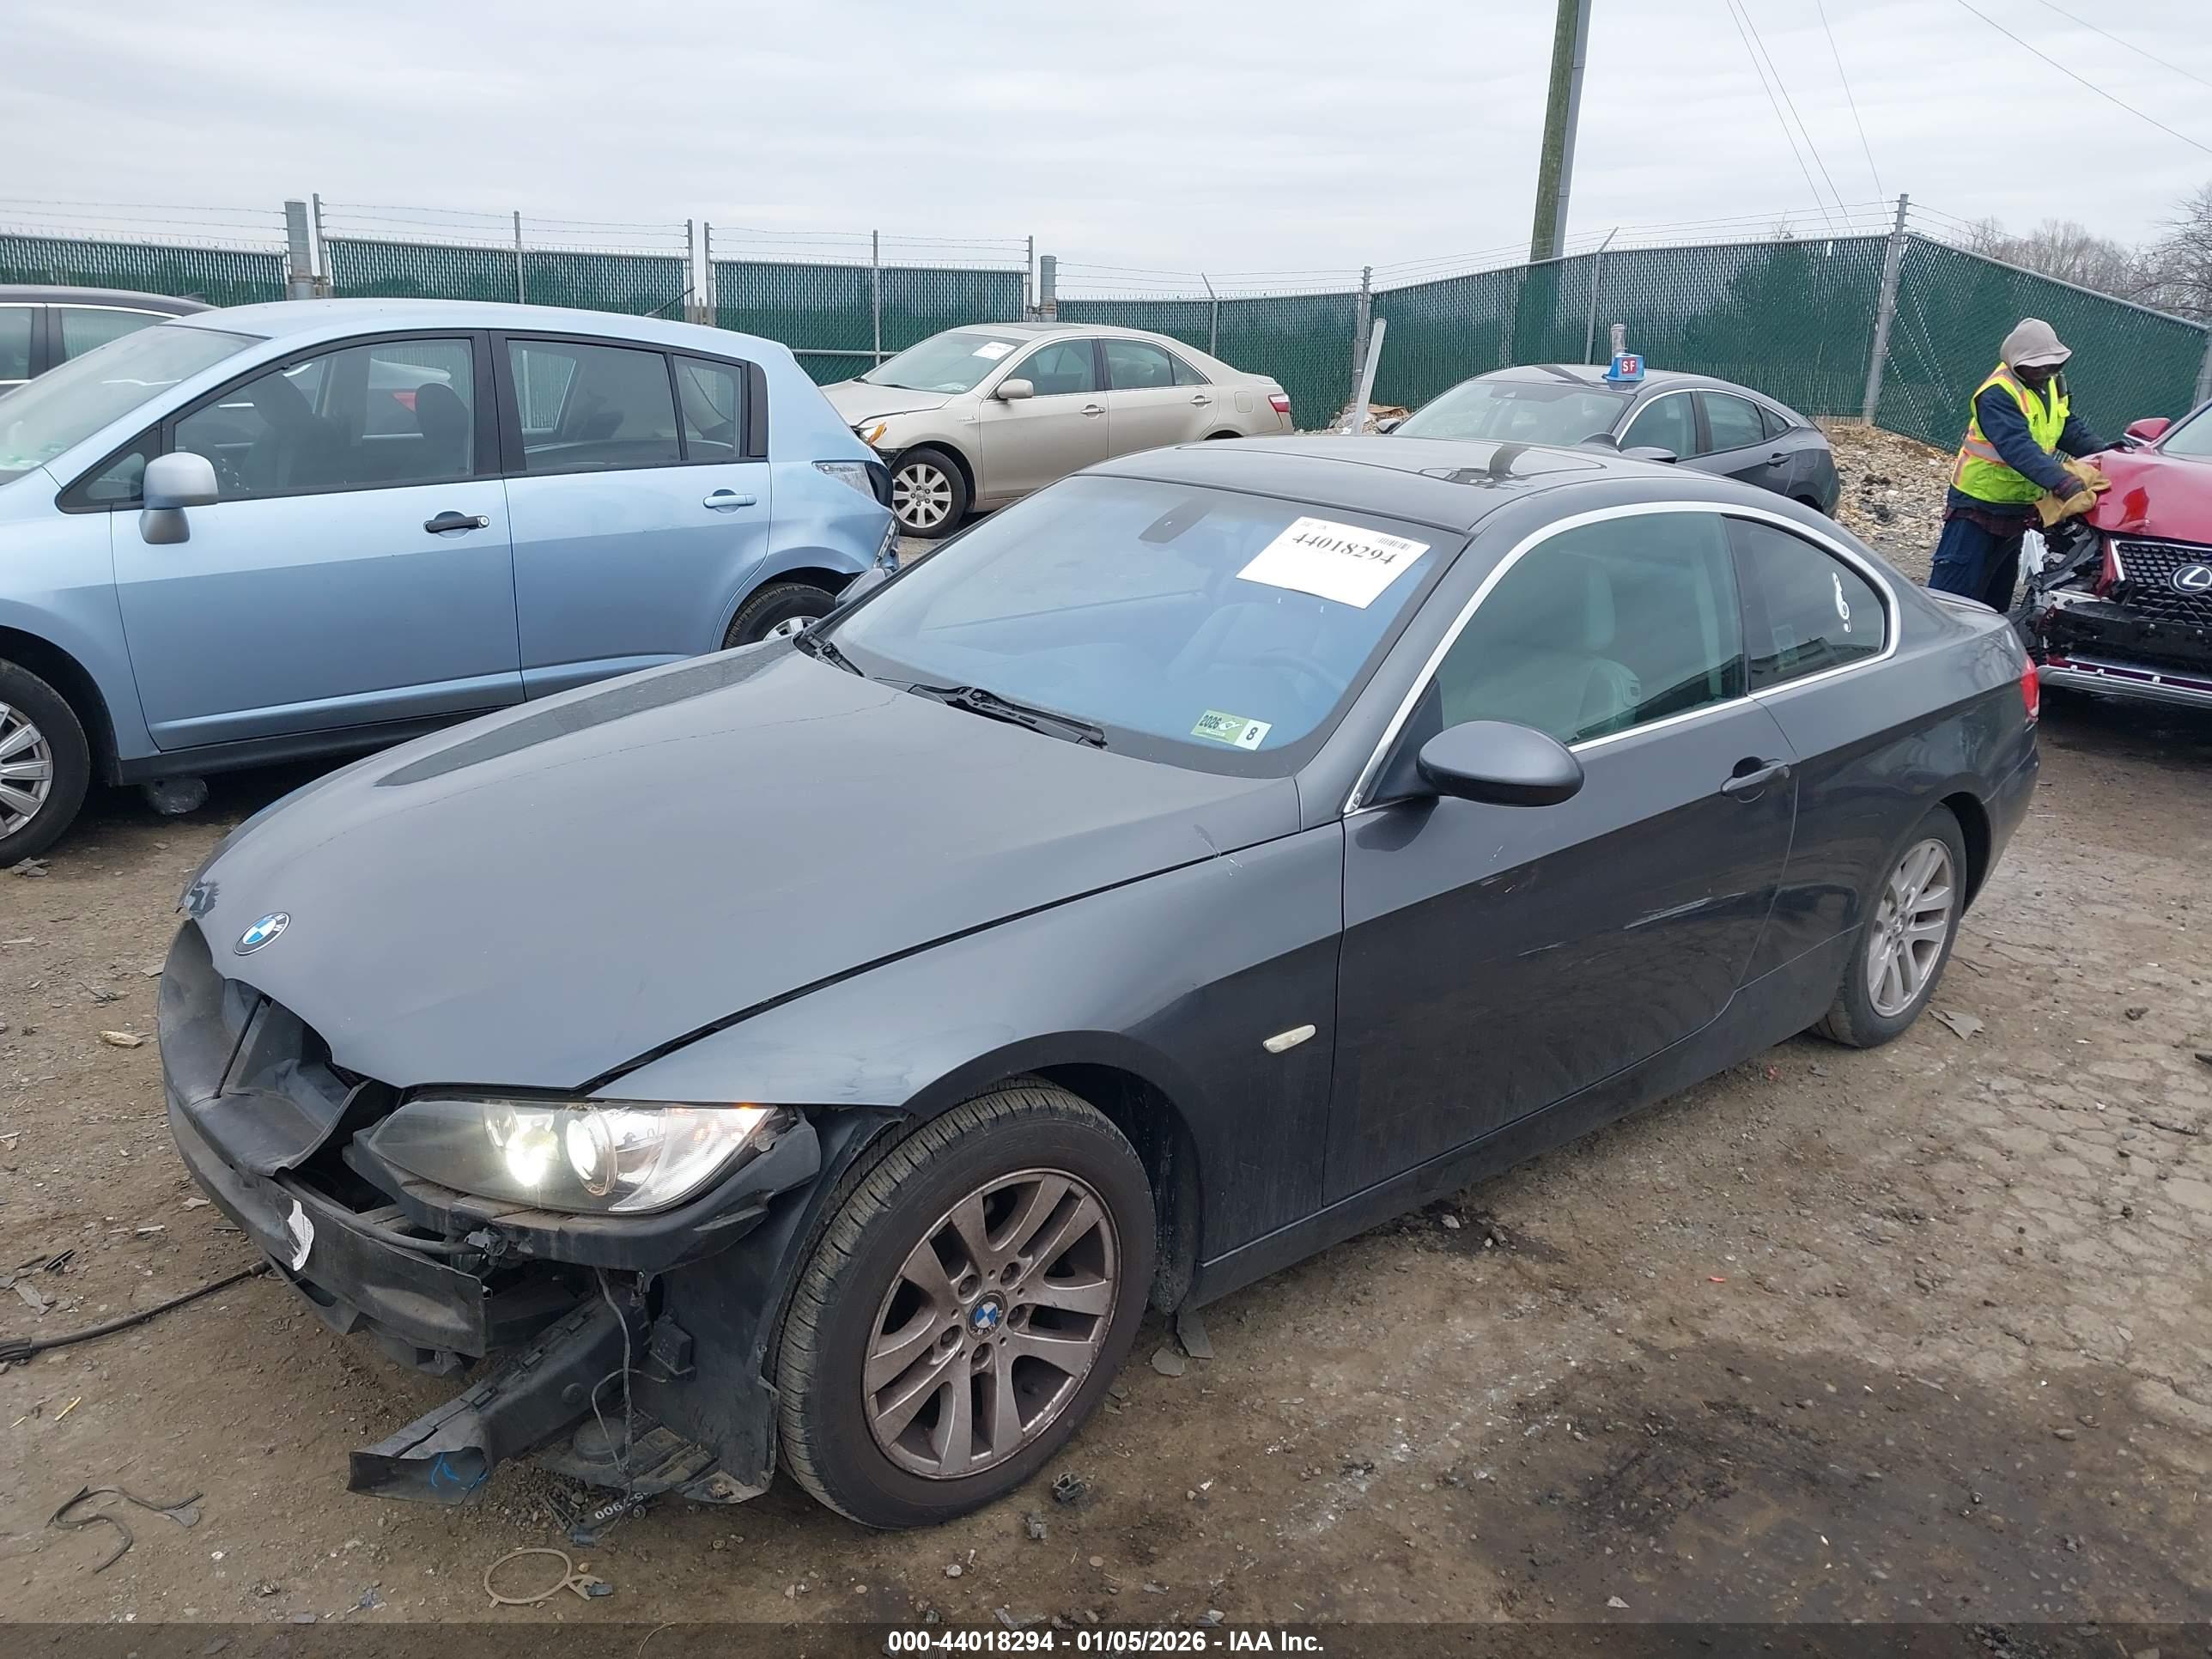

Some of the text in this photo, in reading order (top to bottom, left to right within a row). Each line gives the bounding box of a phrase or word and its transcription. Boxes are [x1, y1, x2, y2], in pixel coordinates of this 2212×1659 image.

[1291, 532, 1398, 565] 44018294
[1199, 714, 1258, 741] 2026 8
